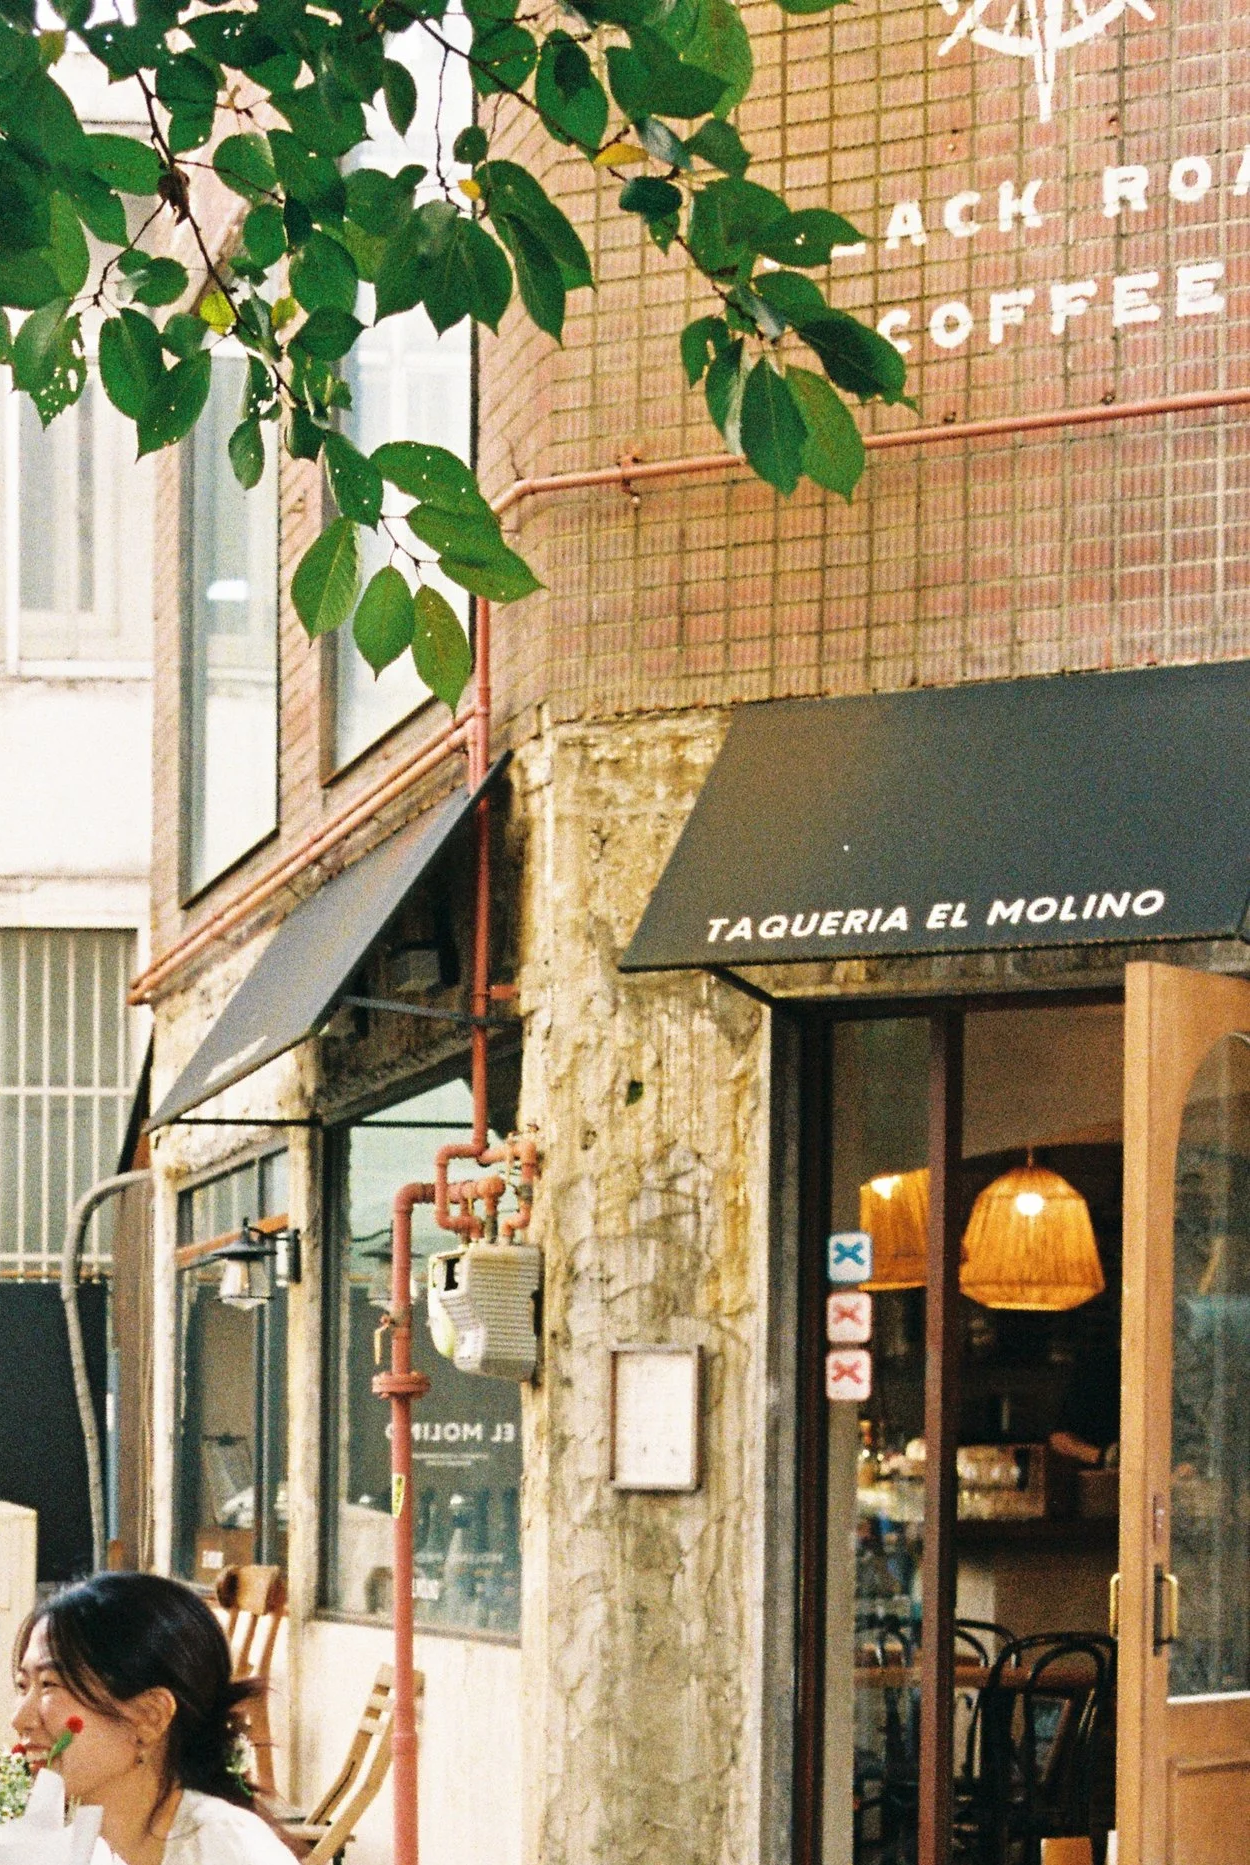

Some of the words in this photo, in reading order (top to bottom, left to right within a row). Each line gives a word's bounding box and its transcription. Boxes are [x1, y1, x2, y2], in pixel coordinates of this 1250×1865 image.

[877, 262, 1225, 354] COFFEE
[706, 906, 909, 943] TAQUERIA
[925, 902, 969, 930] EL
[986, 889, 1166, 926] MOLINO
